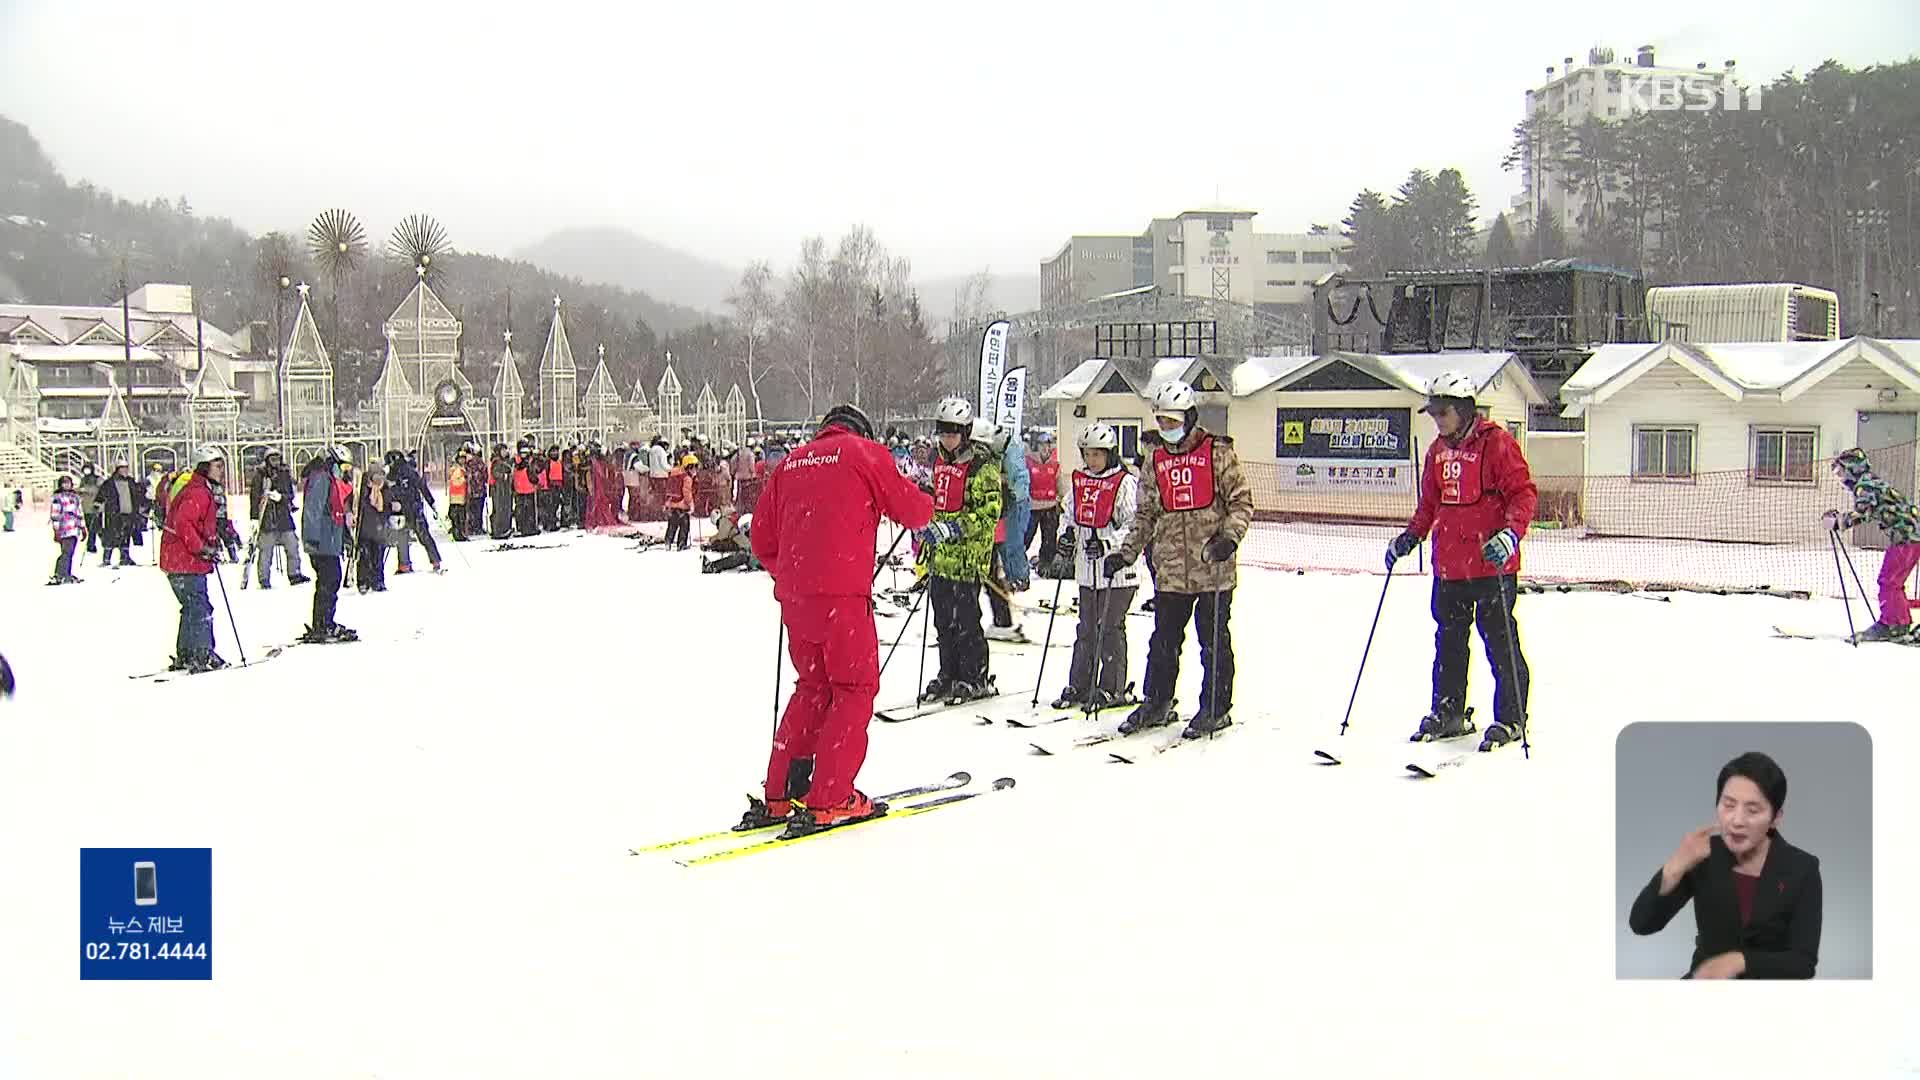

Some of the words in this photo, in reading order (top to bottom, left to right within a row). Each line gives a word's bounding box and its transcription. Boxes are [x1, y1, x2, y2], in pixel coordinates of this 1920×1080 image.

[1170, 467, 1192, 486] 90
[1442, 461, 1461, 480] 89
[1081, 487, 1100, 503] 54
